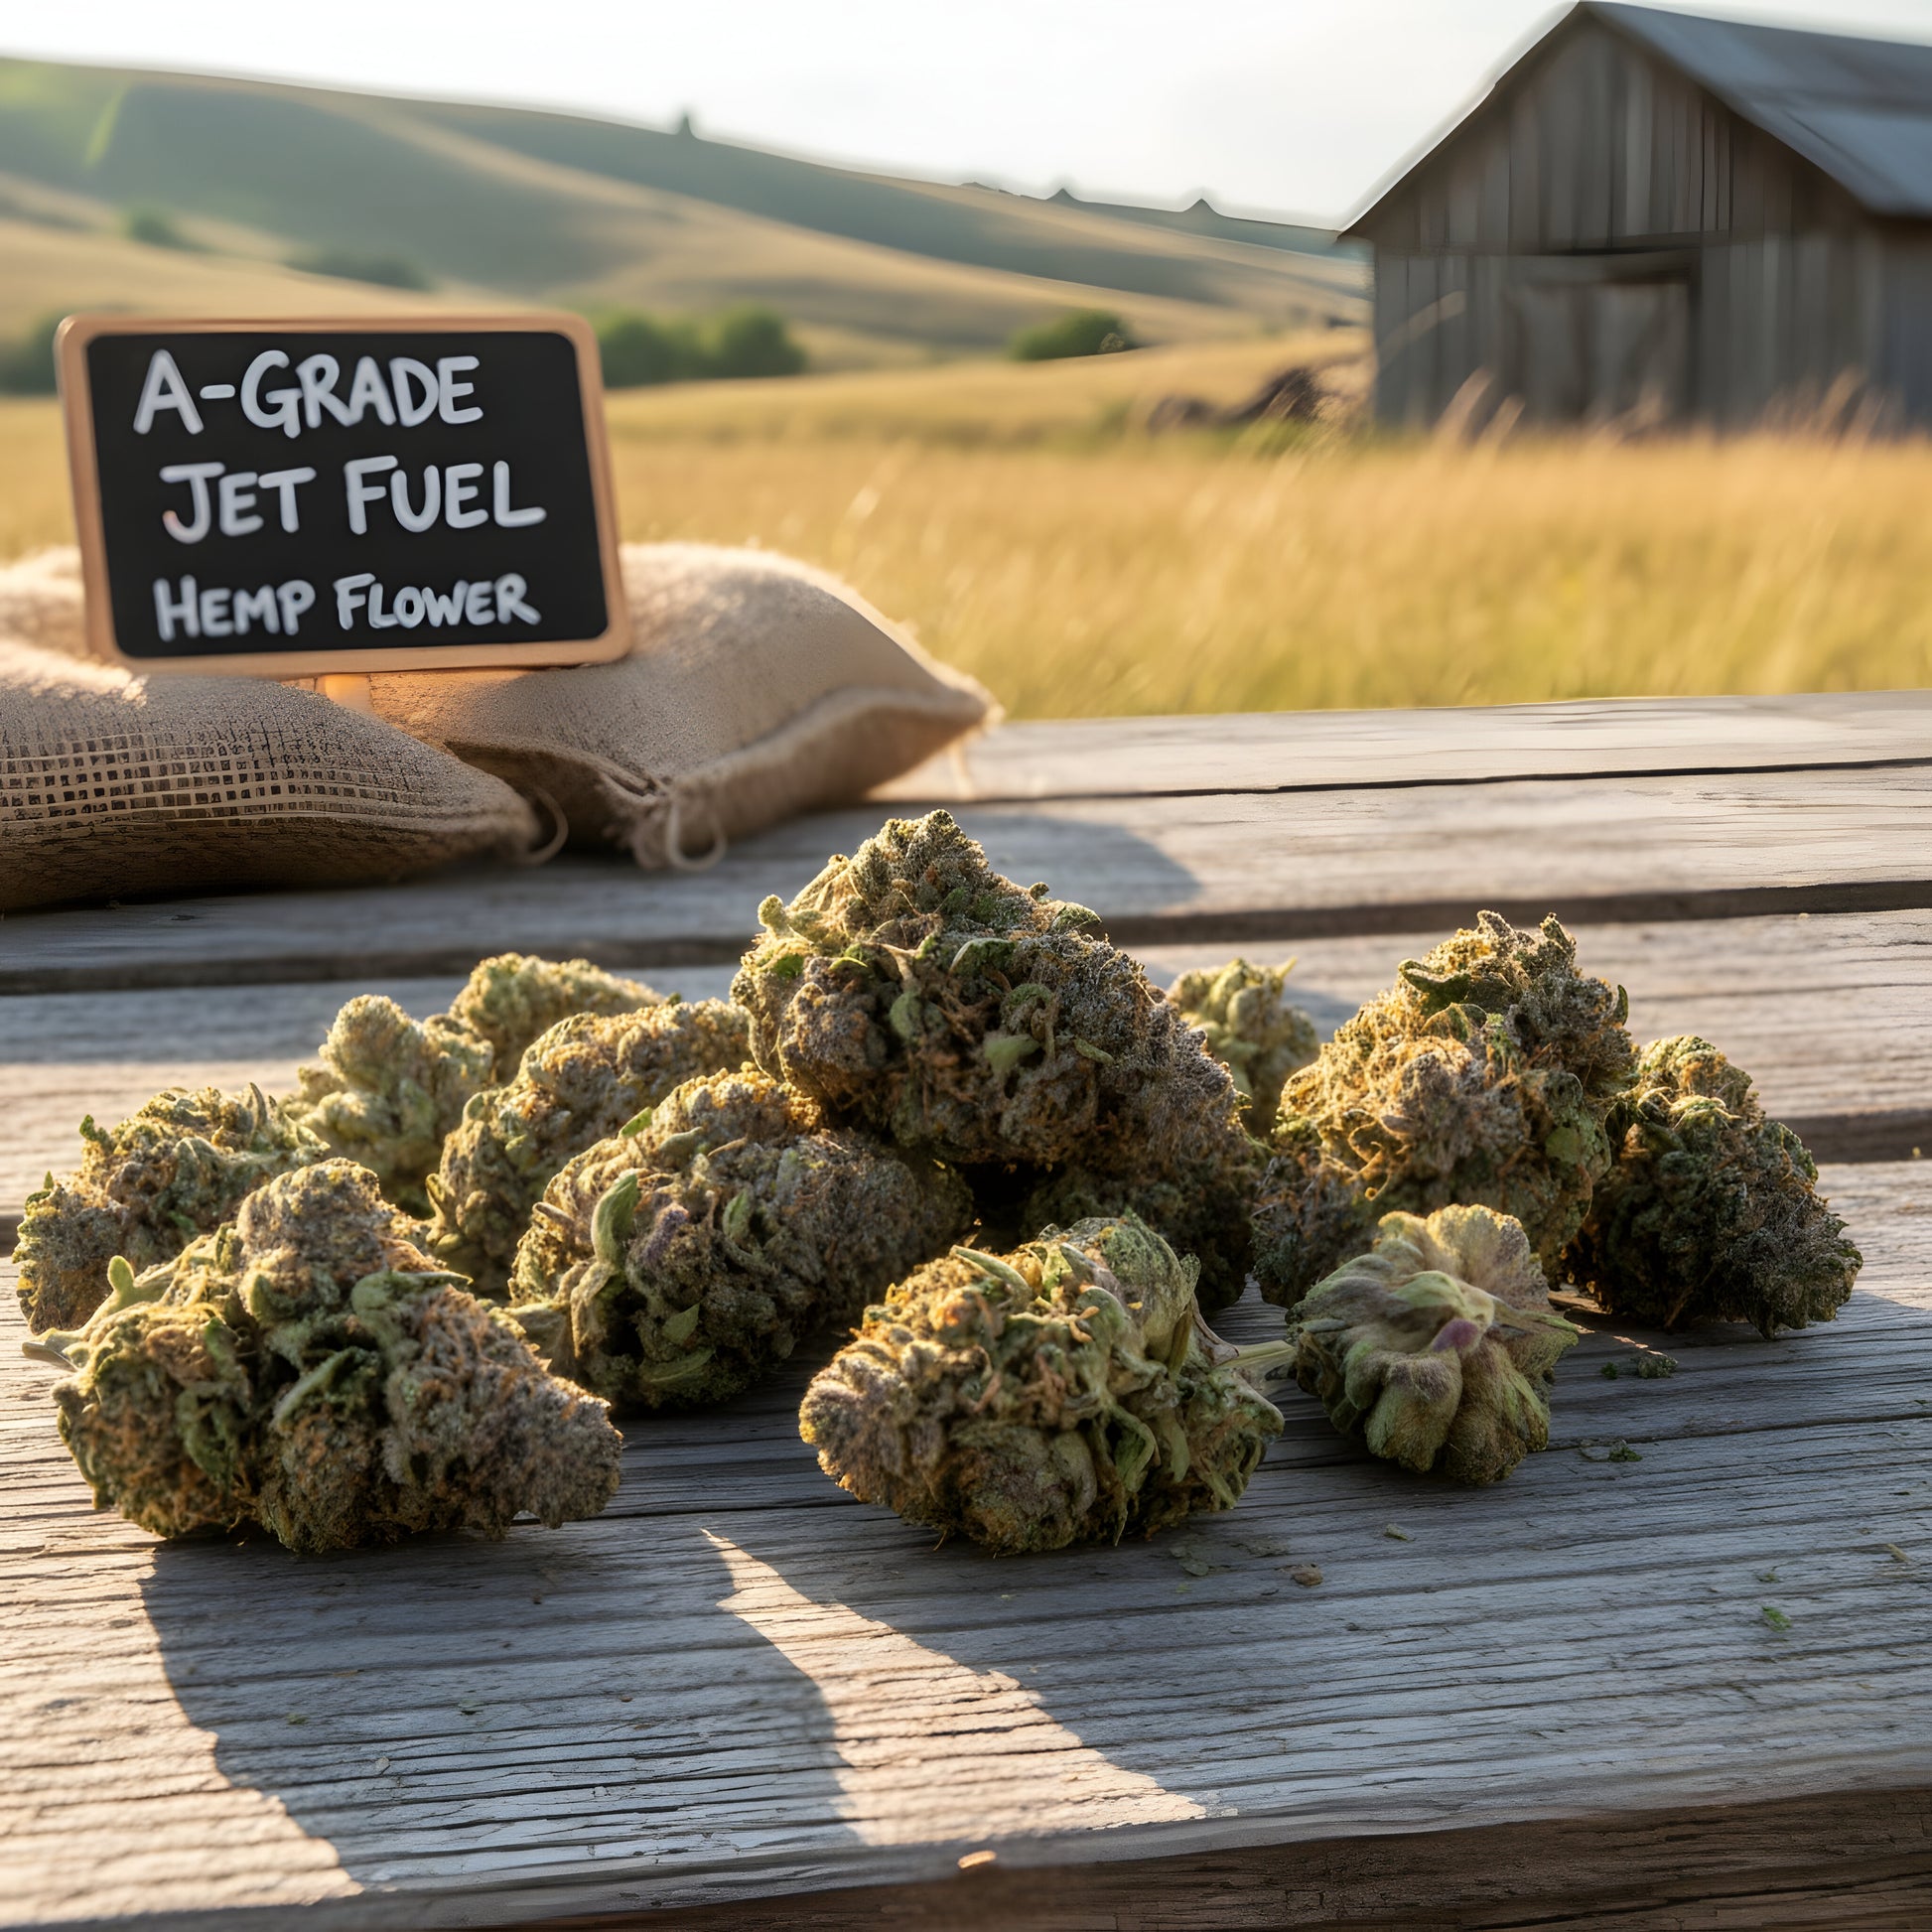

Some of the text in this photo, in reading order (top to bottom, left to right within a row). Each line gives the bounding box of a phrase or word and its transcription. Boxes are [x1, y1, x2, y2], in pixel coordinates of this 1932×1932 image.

[132, 348, 484, 439] A-GRADE
[159, 454, 547, 544] JET FUEL
[153, 572, 542, 642] HEMP FLOWER
